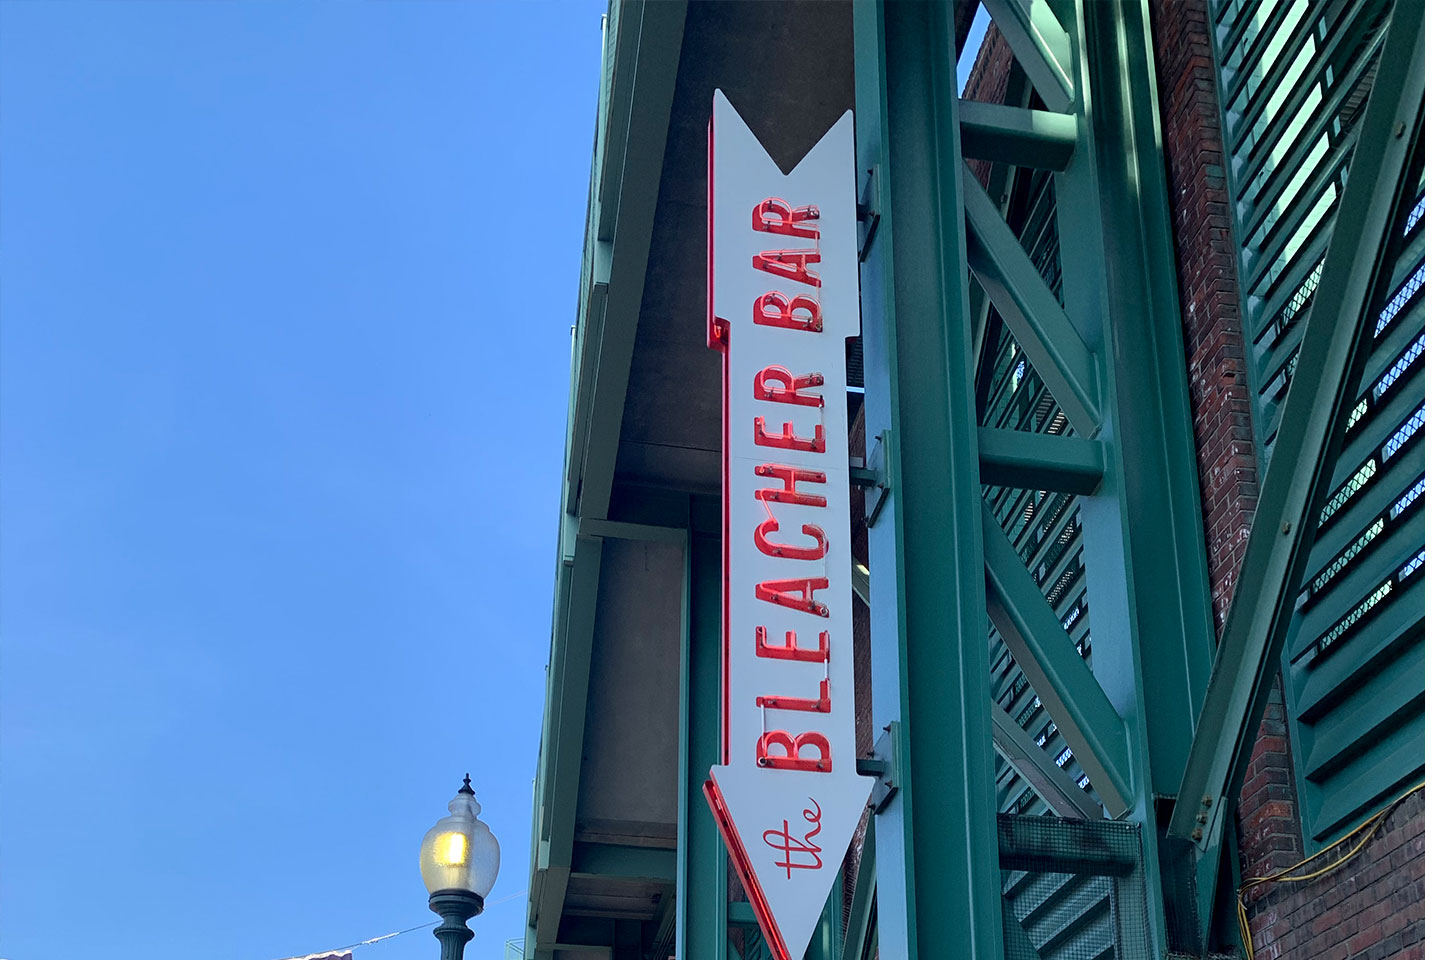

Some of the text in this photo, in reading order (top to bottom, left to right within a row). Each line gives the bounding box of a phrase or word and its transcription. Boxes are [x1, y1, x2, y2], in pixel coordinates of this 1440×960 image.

[752, 197, 832, 880] the BLEACHER BAR
